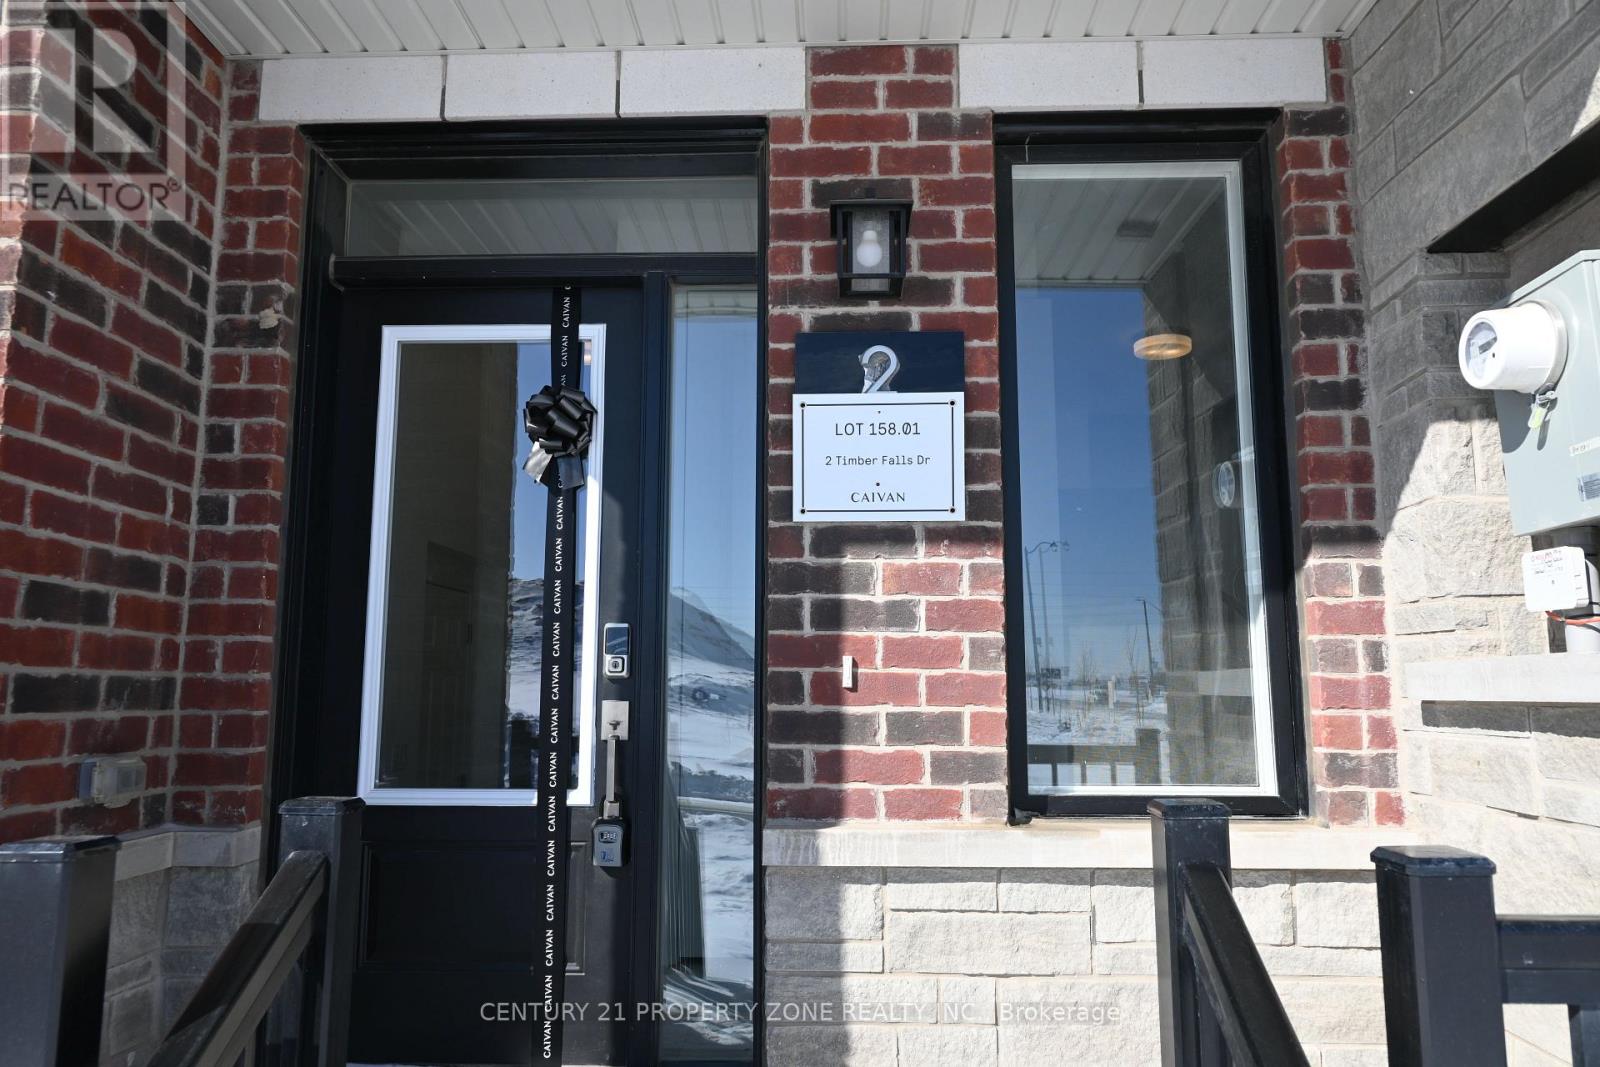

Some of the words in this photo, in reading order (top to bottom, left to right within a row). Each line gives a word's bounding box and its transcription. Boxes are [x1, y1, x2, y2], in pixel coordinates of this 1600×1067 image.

[563, 297, 571, 328] CAIVAN
[561, 336, 569, 367] CAIVAN
[861, 345, 900, 393] 2
[835, 423, 864, 435] LOT
[869, 422, 921, 435] 158.01
[825, 456, 832, 466] 2
[836, 456, 878, 466] Timber
[882, 456, 913, 465] Falls
[917, 455, 931, 465] Dr
[850, 492, 906, 503] CAIVAN
[555, 537, 563, 572] CAIVAN
[554, 580, 562, 615] CAIVAN
[552, 622, 561, 657] CAIVAN
[551, 665, 560, 700] CAIVAN
[550, 708, 559, 743] CAIVAN
[549, 752, 558, 787] CAIVAN
[548, 795, 557, 831] CAIVAN
[547, 839, 556, 876] CAIVAN
[546, 884, 555, 921] CAIVAN
[545, 929, 554, 966] CAIVAN
[544, 975, 553, 1012] CAIVAN
[543, 1021, 552, 1059] CAIVAN
